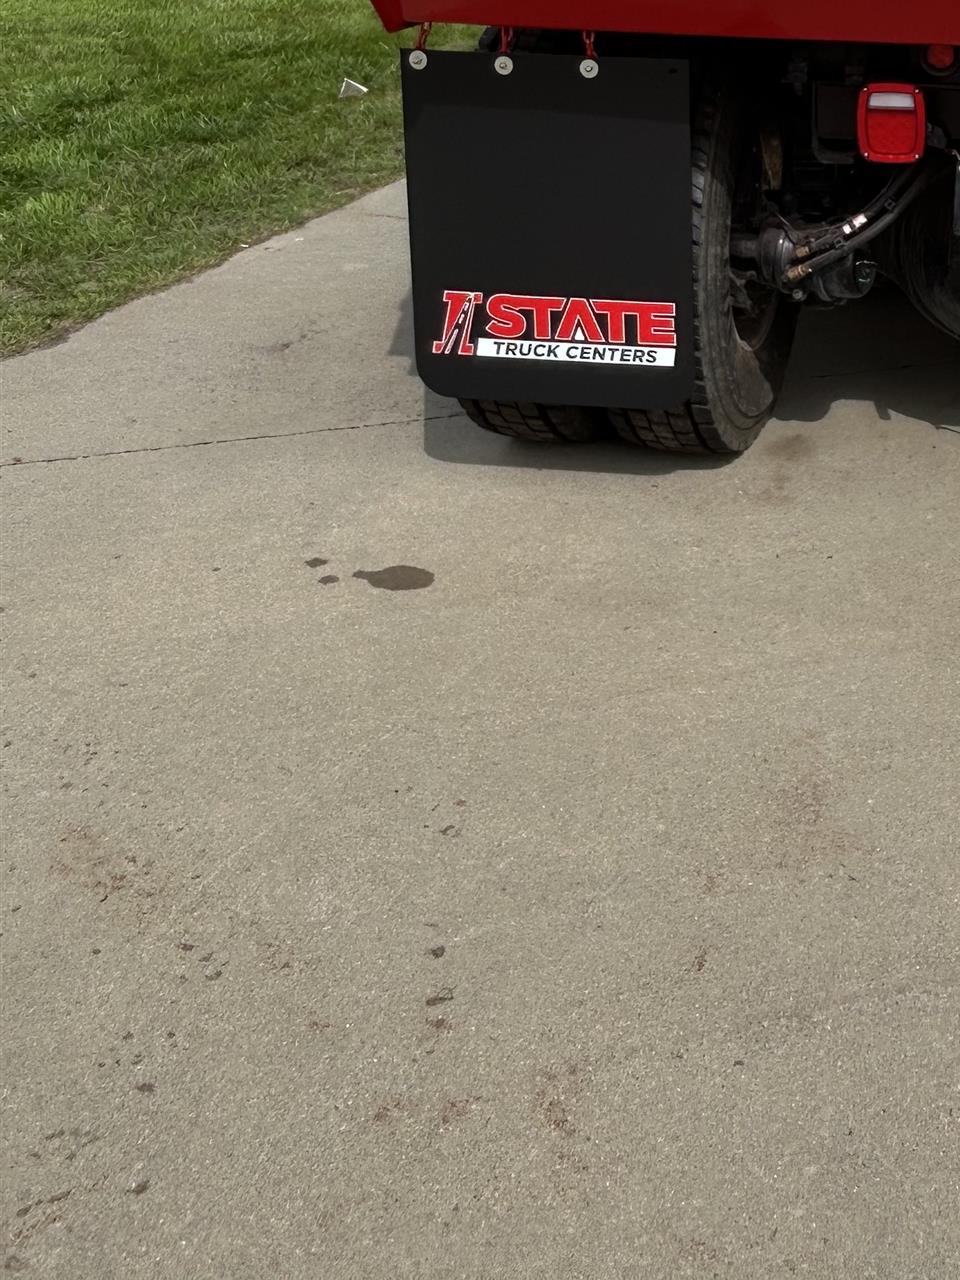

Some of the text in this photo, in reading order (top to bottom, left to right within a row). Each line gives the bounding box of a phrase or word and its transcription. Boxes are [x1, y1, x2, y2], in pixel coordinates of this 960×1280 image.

[486, 293, 677, 346] STATE
[493, 341, 658, 363] TRUCK CENTERS
